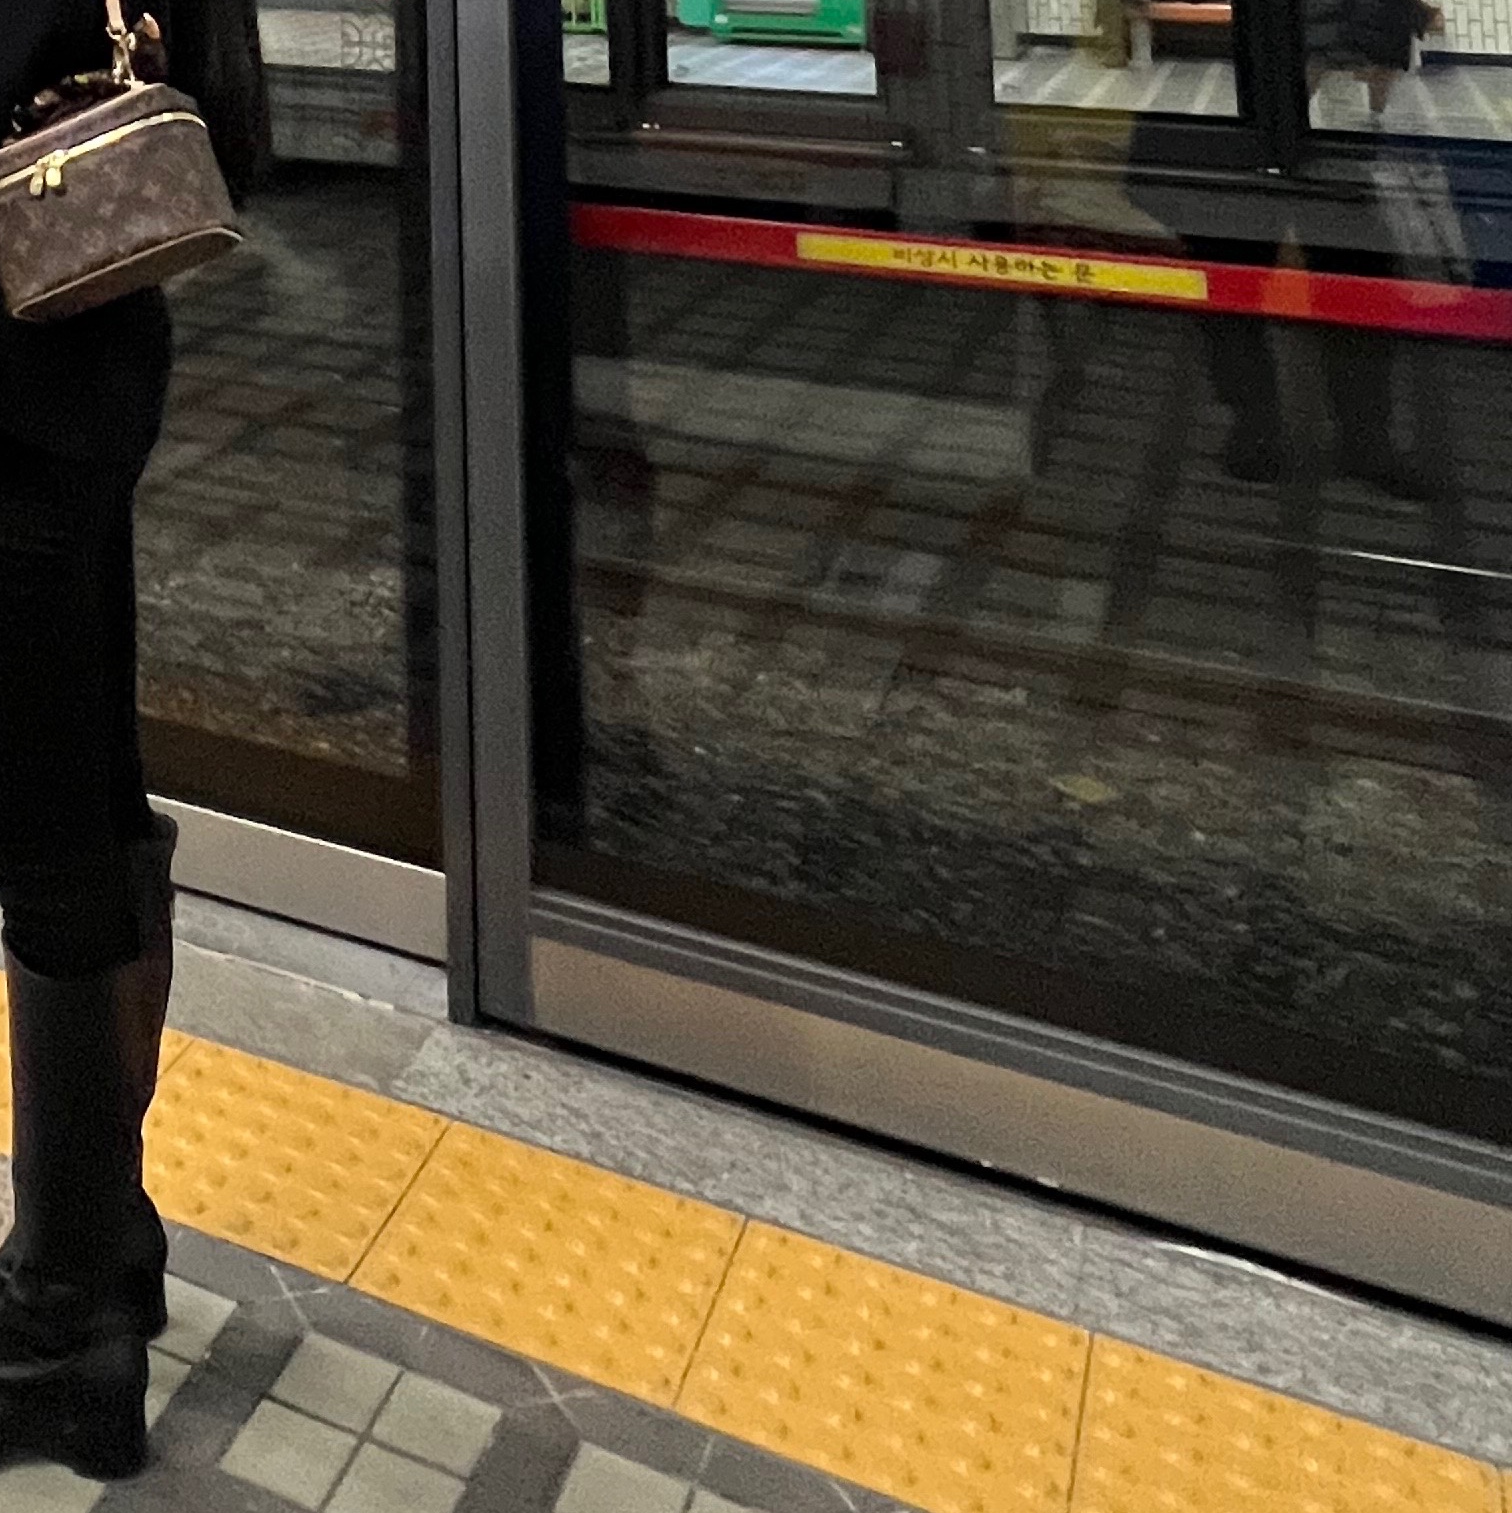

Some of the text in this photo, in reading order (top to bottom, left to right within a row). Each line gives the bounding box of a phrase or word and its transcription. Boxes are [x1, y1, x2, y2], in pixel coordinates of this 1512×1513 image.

[892, 246, 1095, 284] 비상시 사용하는 문
